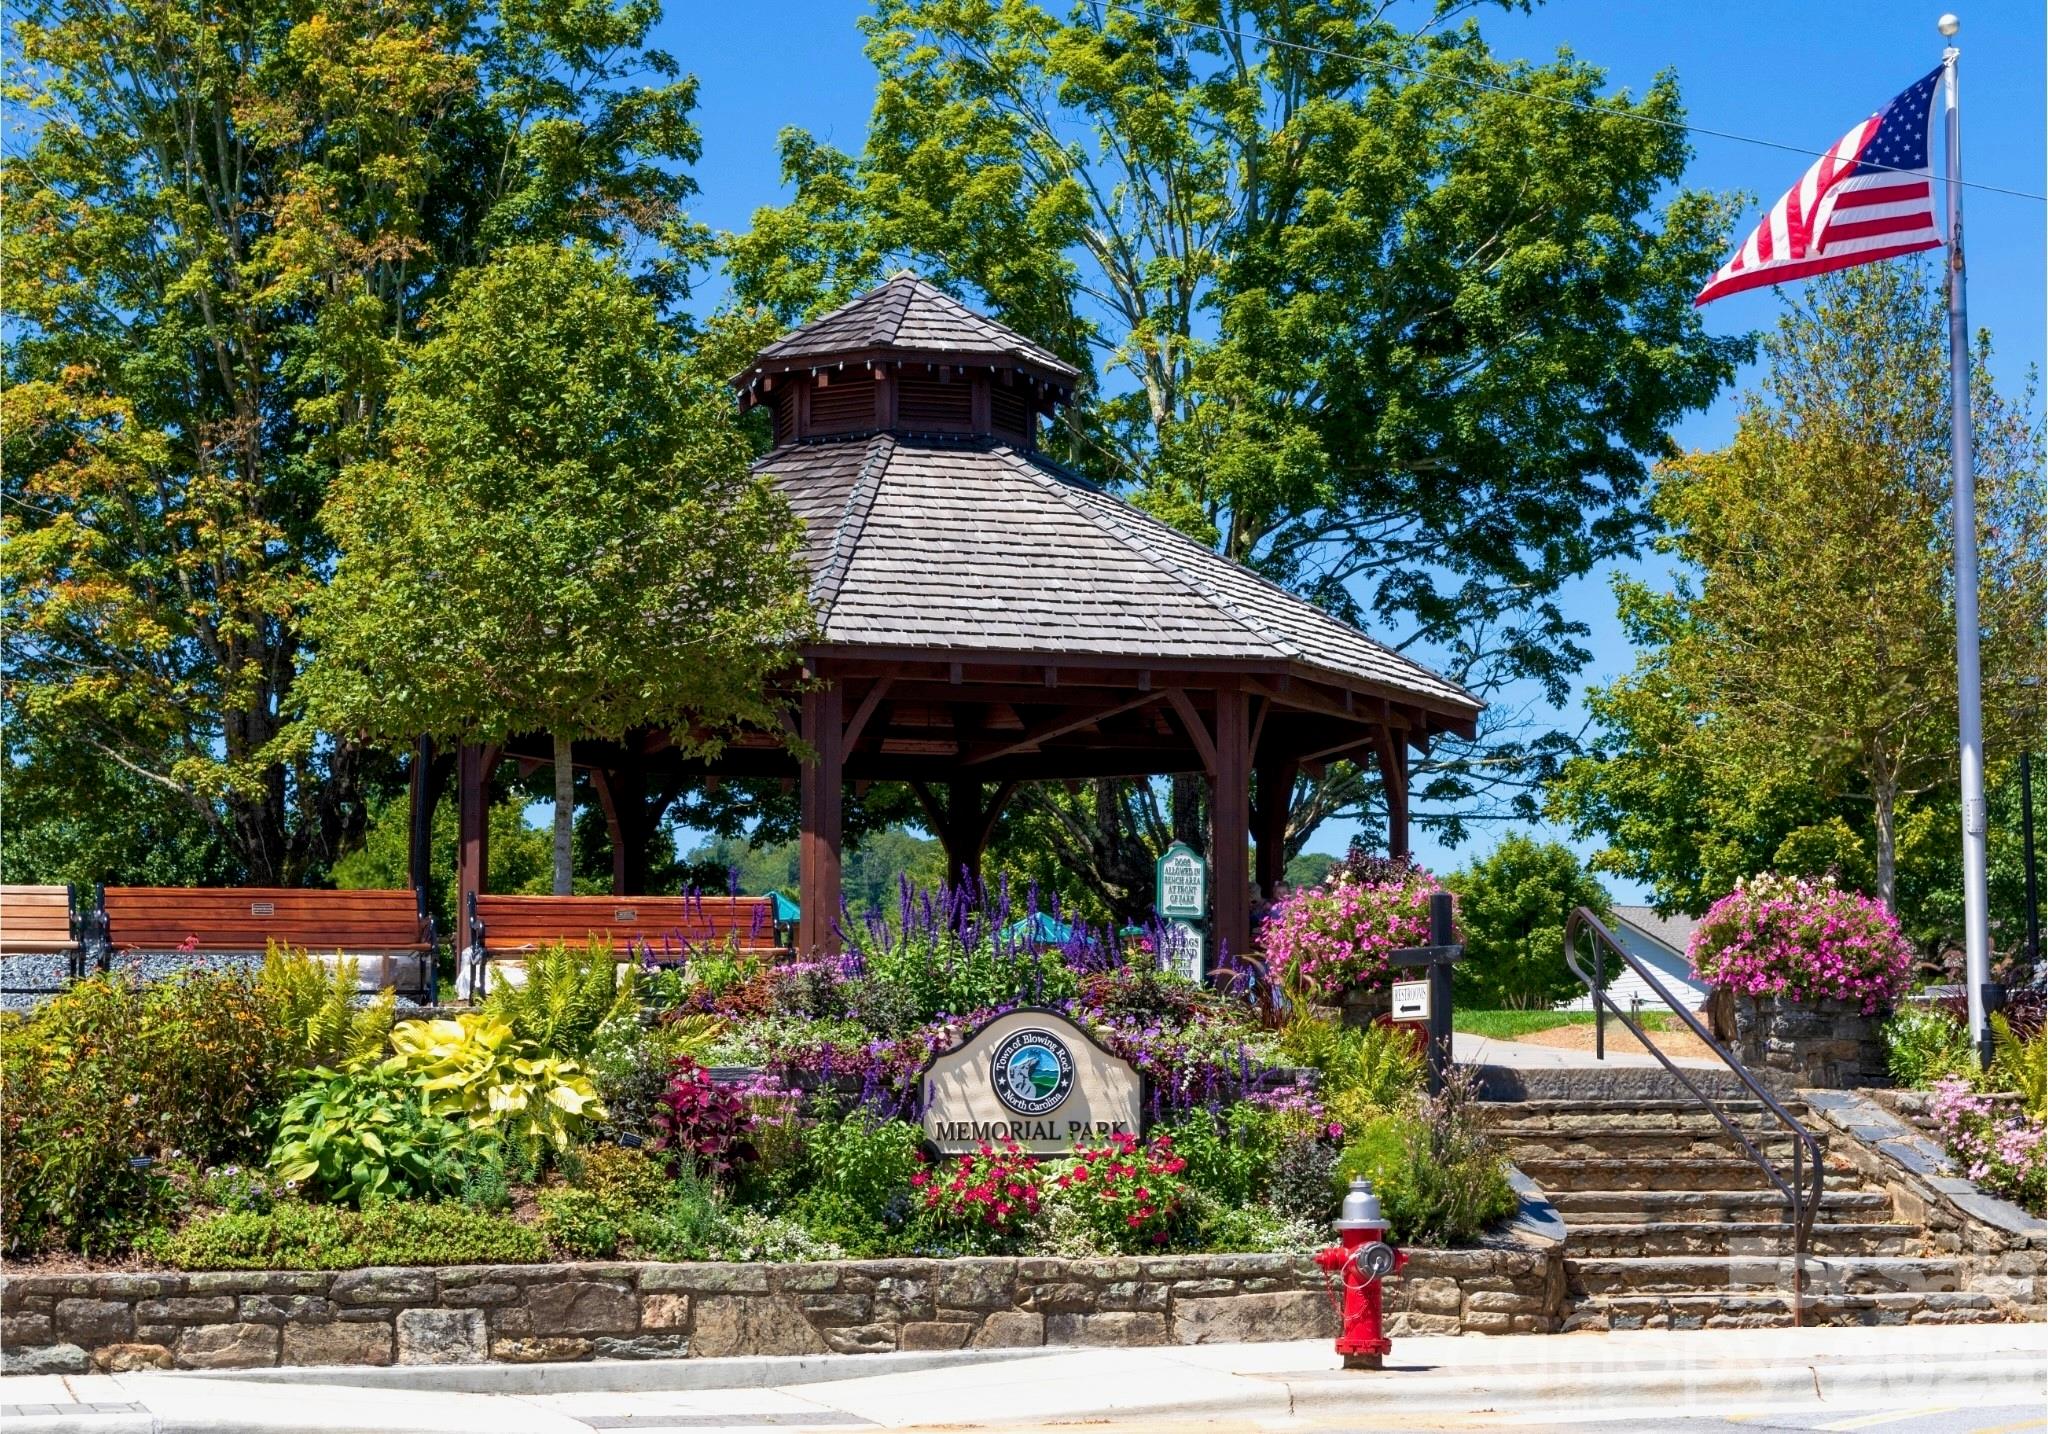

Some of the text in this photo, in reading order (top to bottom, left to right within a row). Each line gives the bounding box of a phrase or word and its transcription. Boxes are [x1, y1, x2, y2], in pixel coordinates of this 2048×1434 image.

[1165, 867, 1193, 876] ALLOWED
[1165, 876, 1200, 885] BENCH AREA
[1168, 886, 1197, 895] AT FRONT
[1170, 895, 1194, 904] OF PARK
[1395, 986, 1425, 1001] RESTROOMS
[996, 1034, 1072, 1073] Town of Blowing Rock
[1003, 1089, 1062, 1111] North Carolina
[936, 1121, 1127, 1141] MEMORIAL PARK
